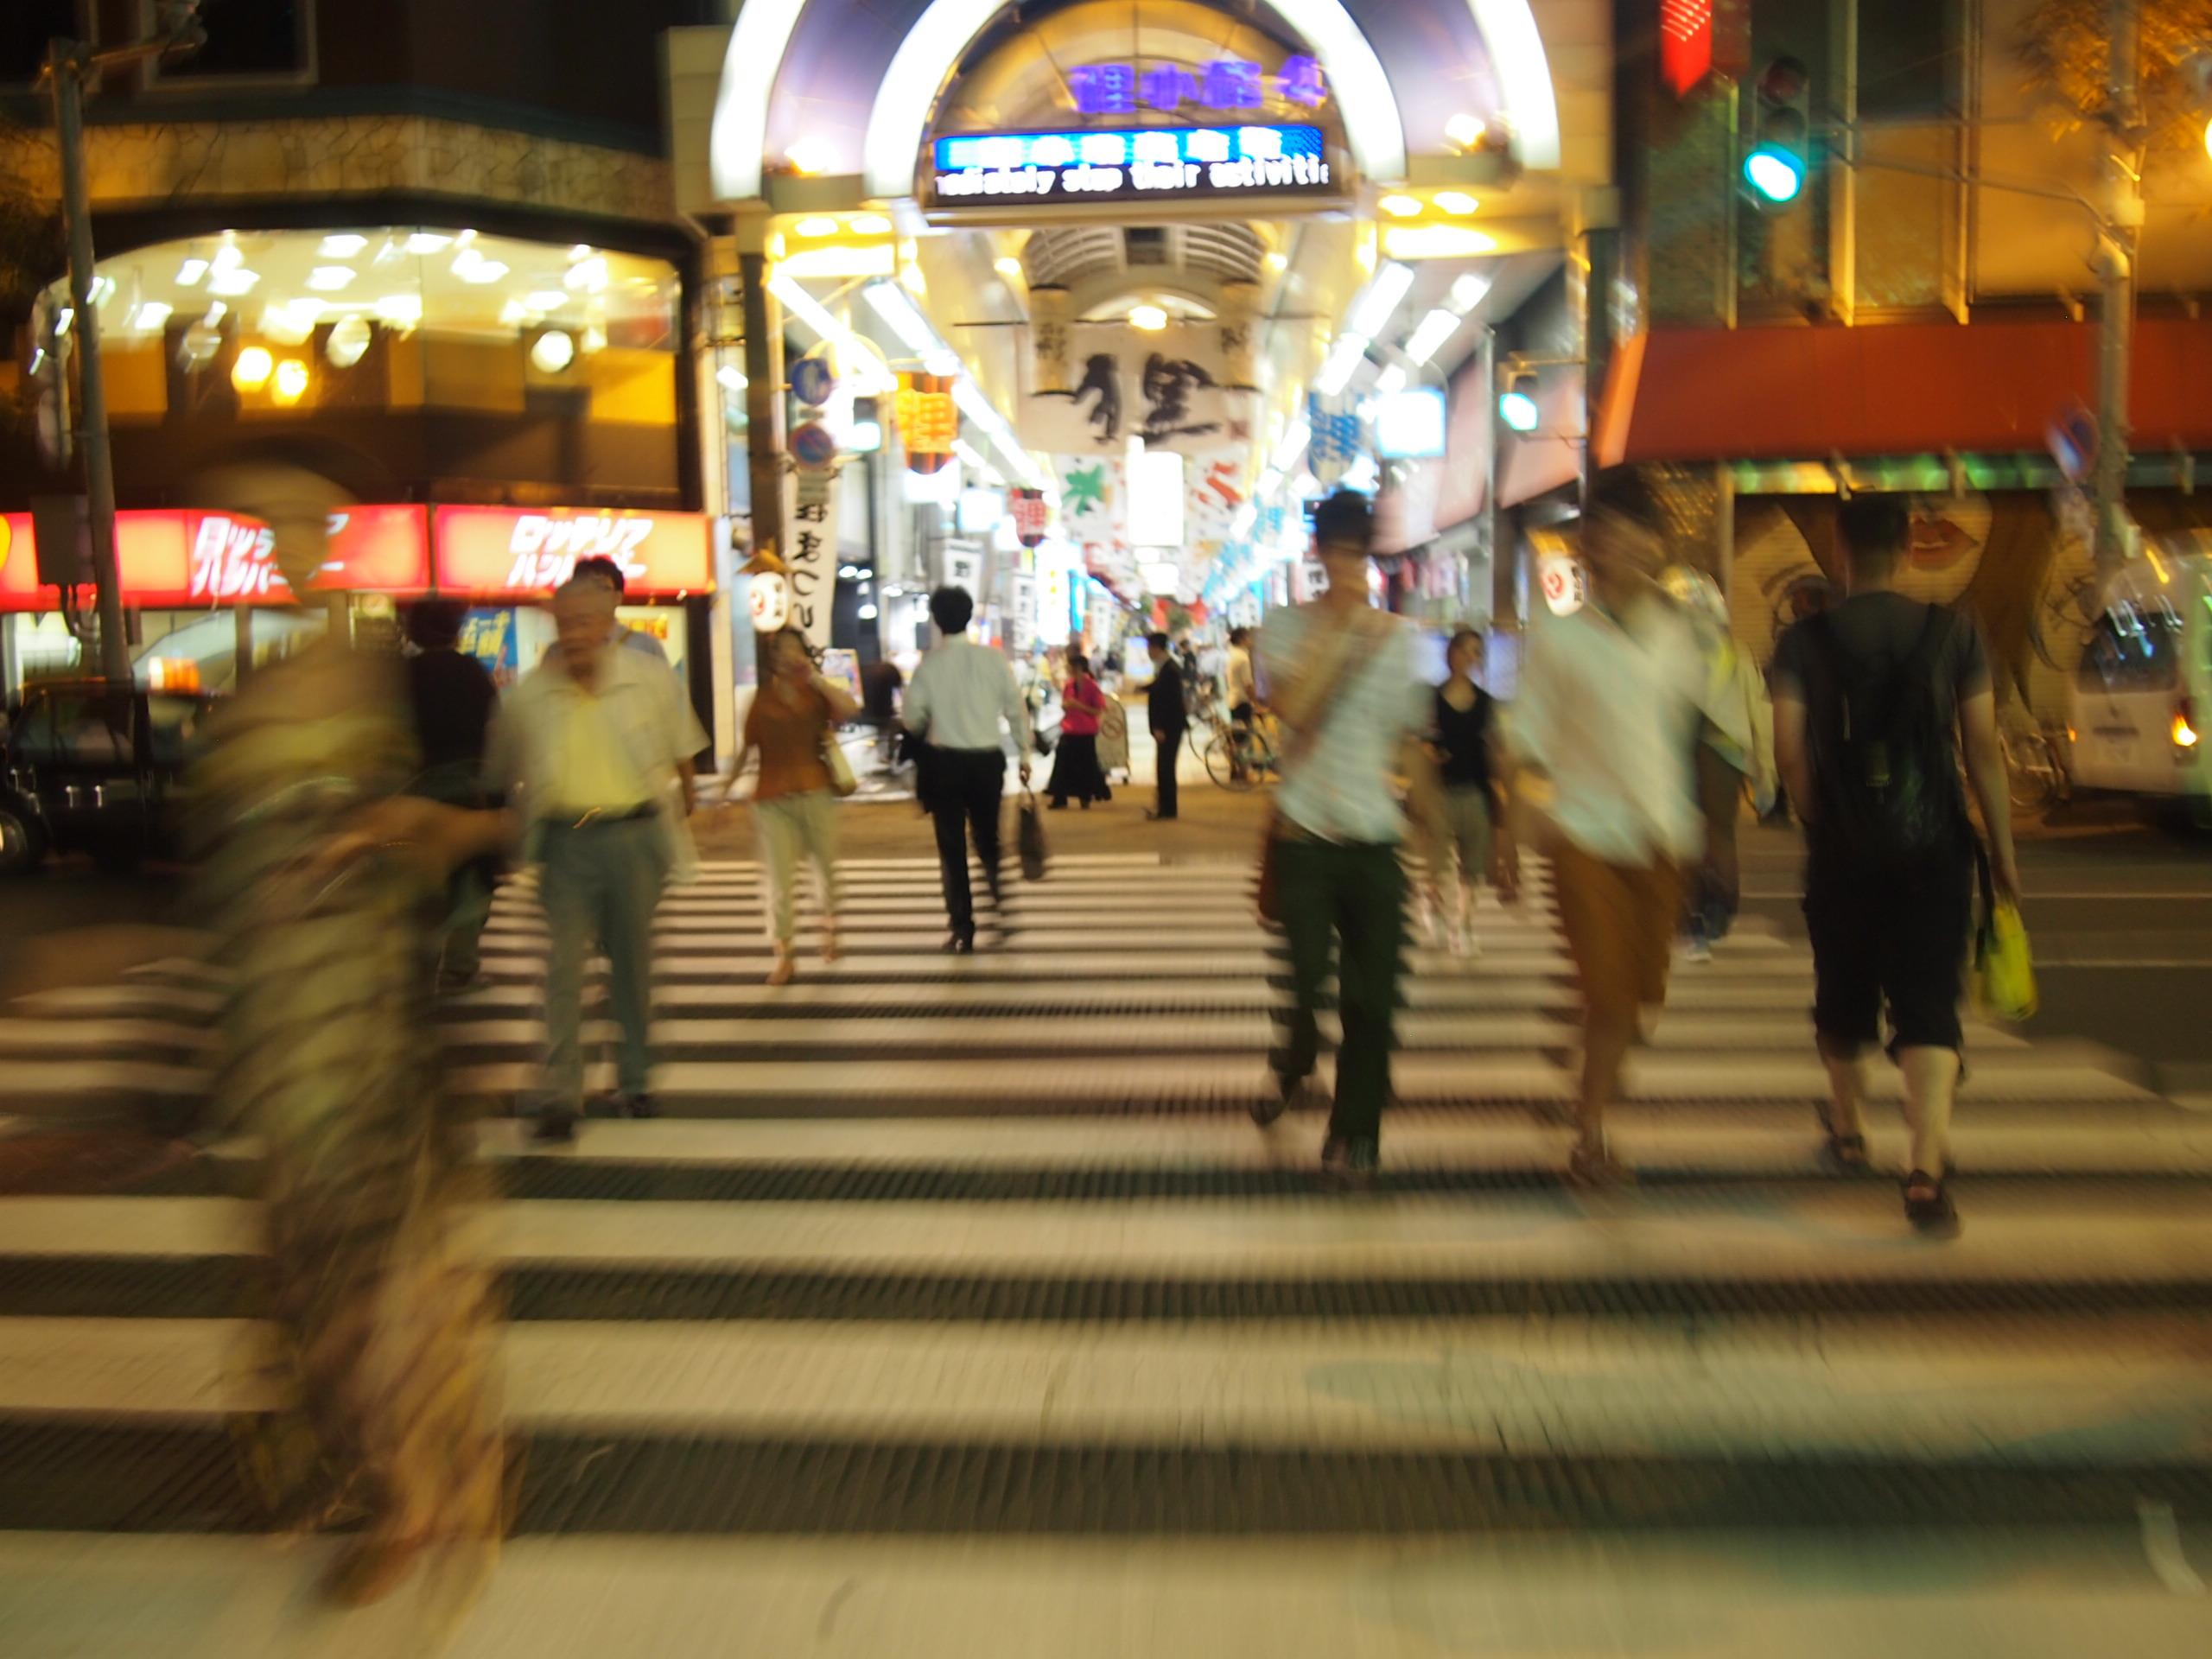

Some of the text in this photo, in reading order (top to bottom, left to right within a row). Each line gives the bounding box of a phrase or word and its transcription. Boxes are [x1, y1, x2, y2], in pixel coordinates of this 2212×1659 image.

[1062, 162, 1123, 192] stop
[1128, 158, 1201, 190] their
[194, 512, 350, 562] ロッテア
[509, 515, 654, 555] ロッテリア
[190, 556, 346, 598] ハンバーー
